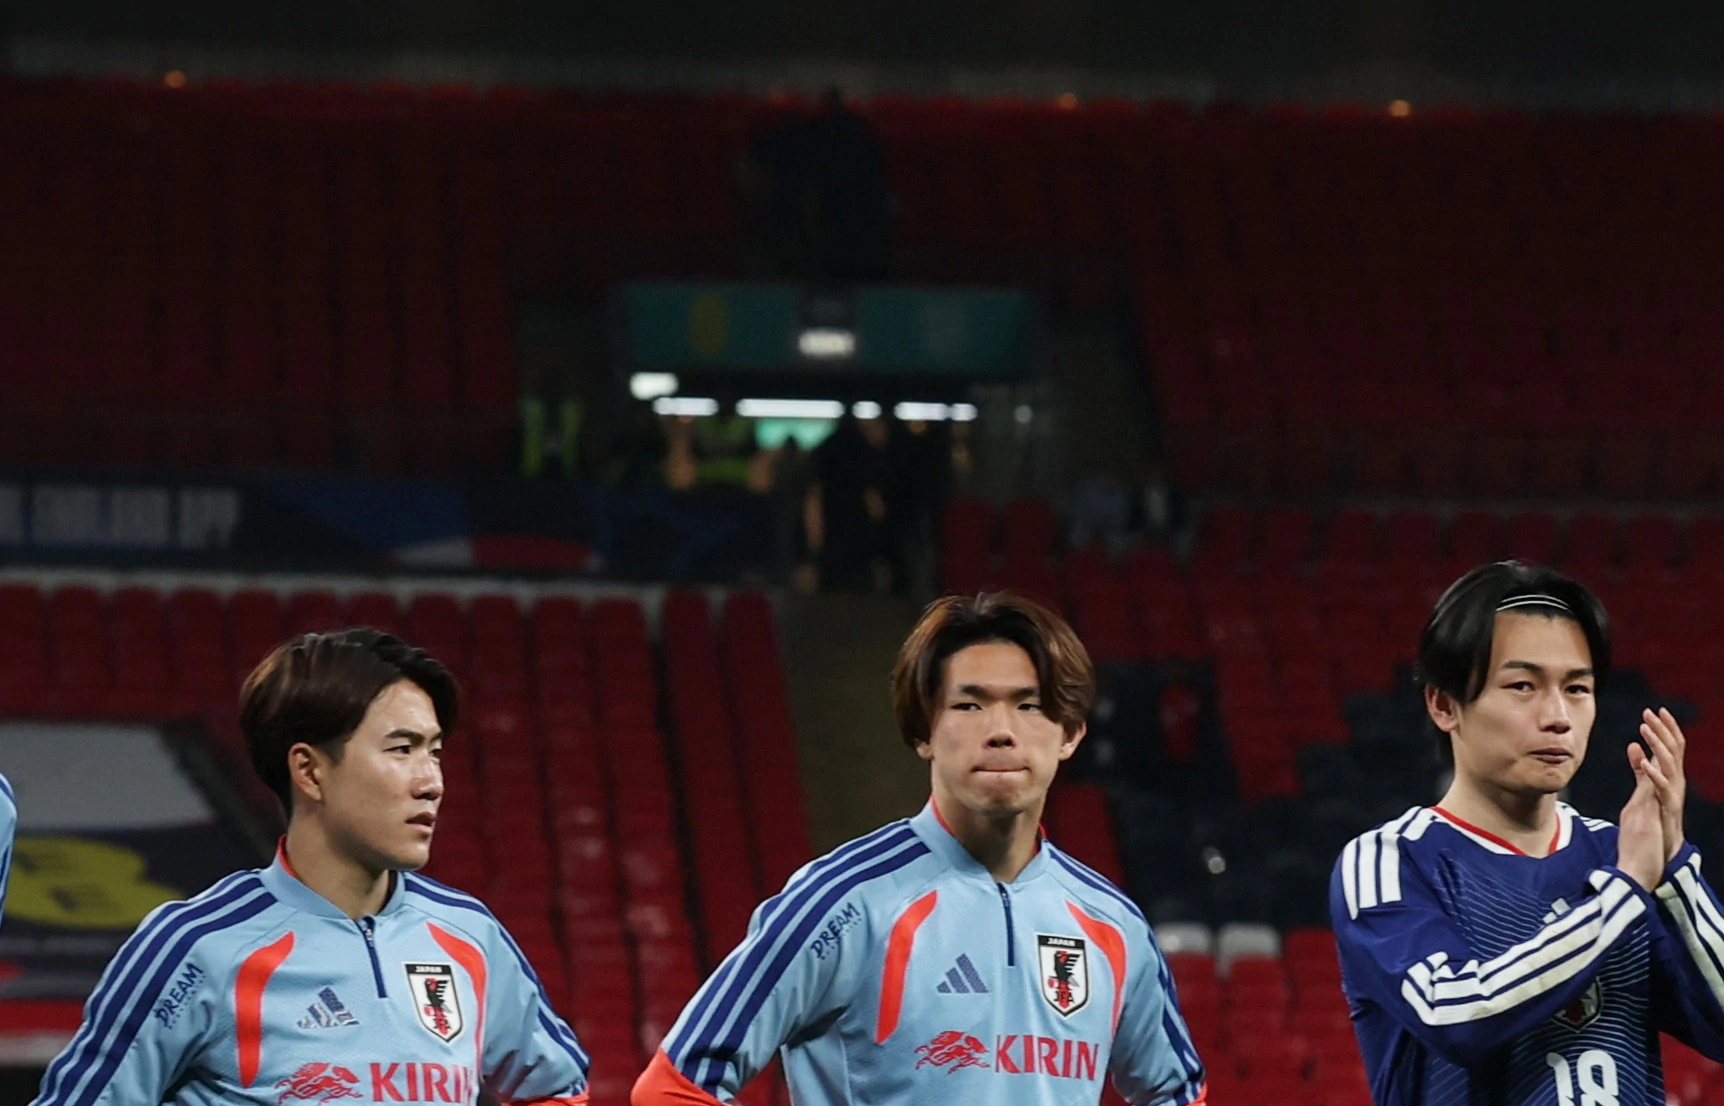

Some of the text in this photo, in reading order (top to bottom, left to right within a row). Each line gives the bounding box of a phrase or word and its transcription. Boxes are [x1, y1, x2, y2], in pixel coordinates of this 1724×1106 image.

[810, 901, 861, 959] DREAM
[153, 962, 204, 1028] DREAM
[995, 1034, 1100, 1081] KIRIN
